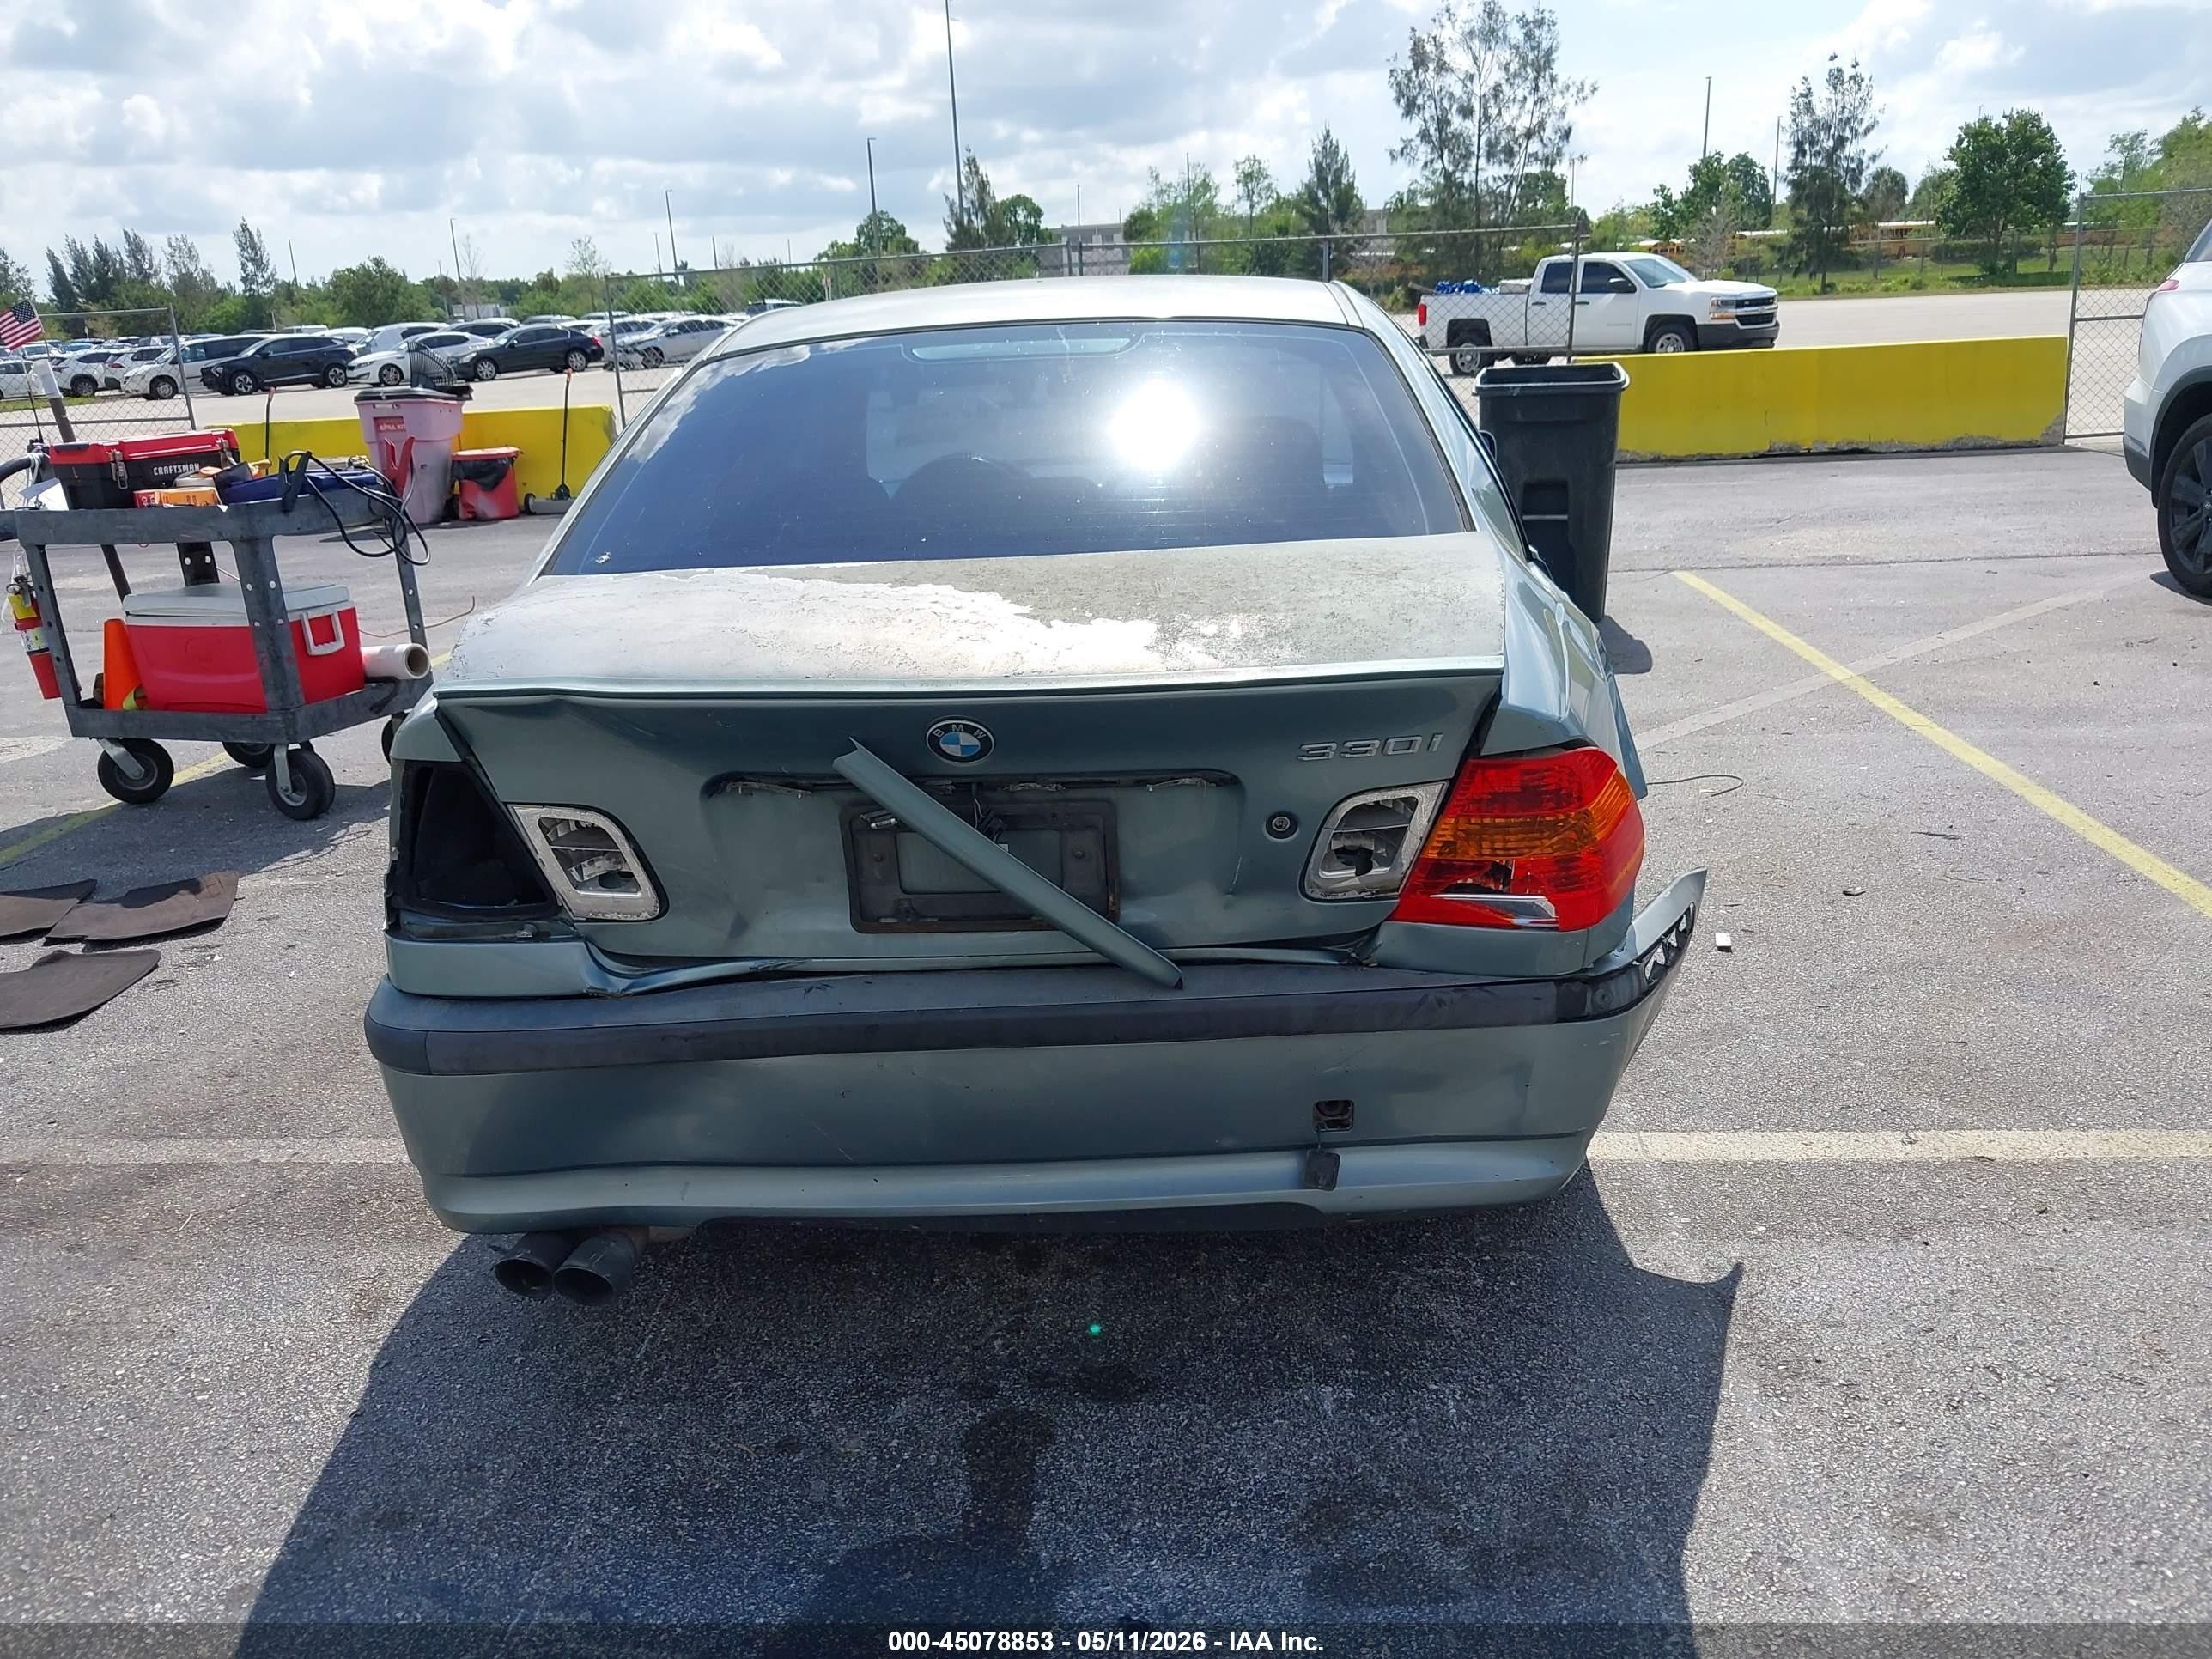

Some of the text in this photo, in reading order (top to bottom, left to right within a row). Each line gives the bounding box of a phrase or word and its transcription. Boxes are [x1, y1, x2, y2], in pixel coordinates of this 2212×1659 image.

[153, 464, 200, 476] CRAFTSMAN
[932, 724, 987, 739] BMW
[1297, 732, 1443, 761] 330i
